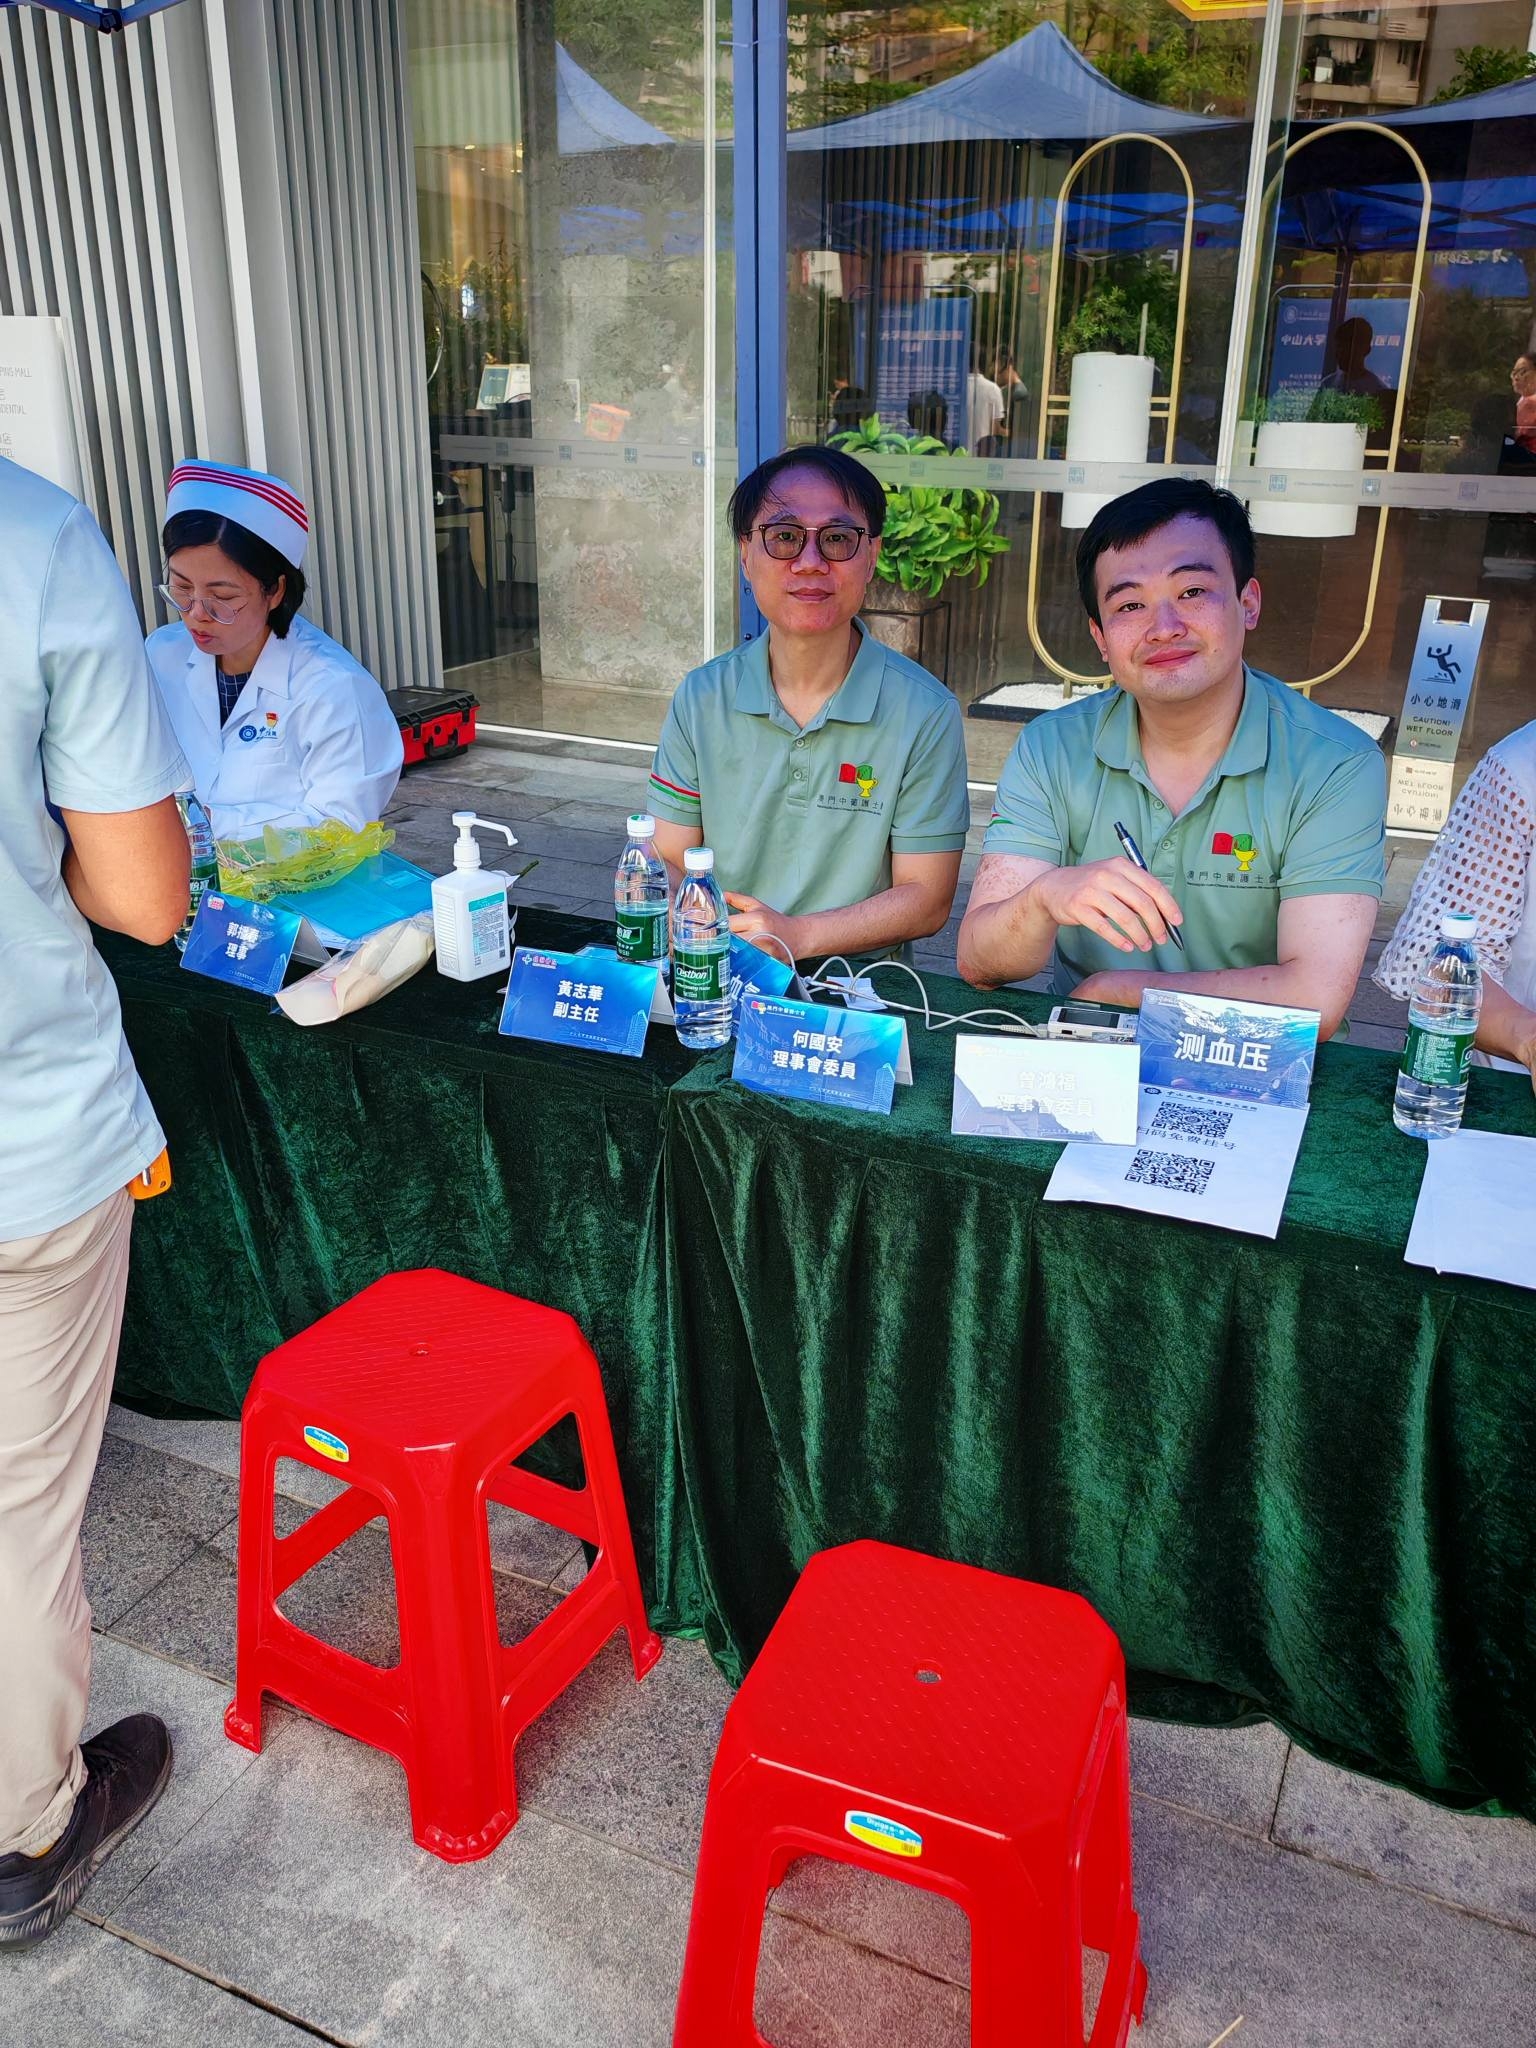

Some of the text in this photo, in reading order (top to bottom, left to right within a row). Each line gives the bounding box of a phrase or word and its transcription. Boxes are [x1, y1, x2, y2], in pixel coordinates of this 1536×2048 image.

[1411, 694, 1462, 710] 小心地滑
[1406, 725, 1454, 737] WET FLOOR
[1413, 716, 1451, 726] CAUTION!
[226, 943, 249, 961] 理事
[552, 1001, 600, 1023] 副主任
[792, 1029, 843, 1054] 何國安
[1174, 1031, 1272, 1073] 测血压
[772, 1050, 856, 1080] 理事會委員
